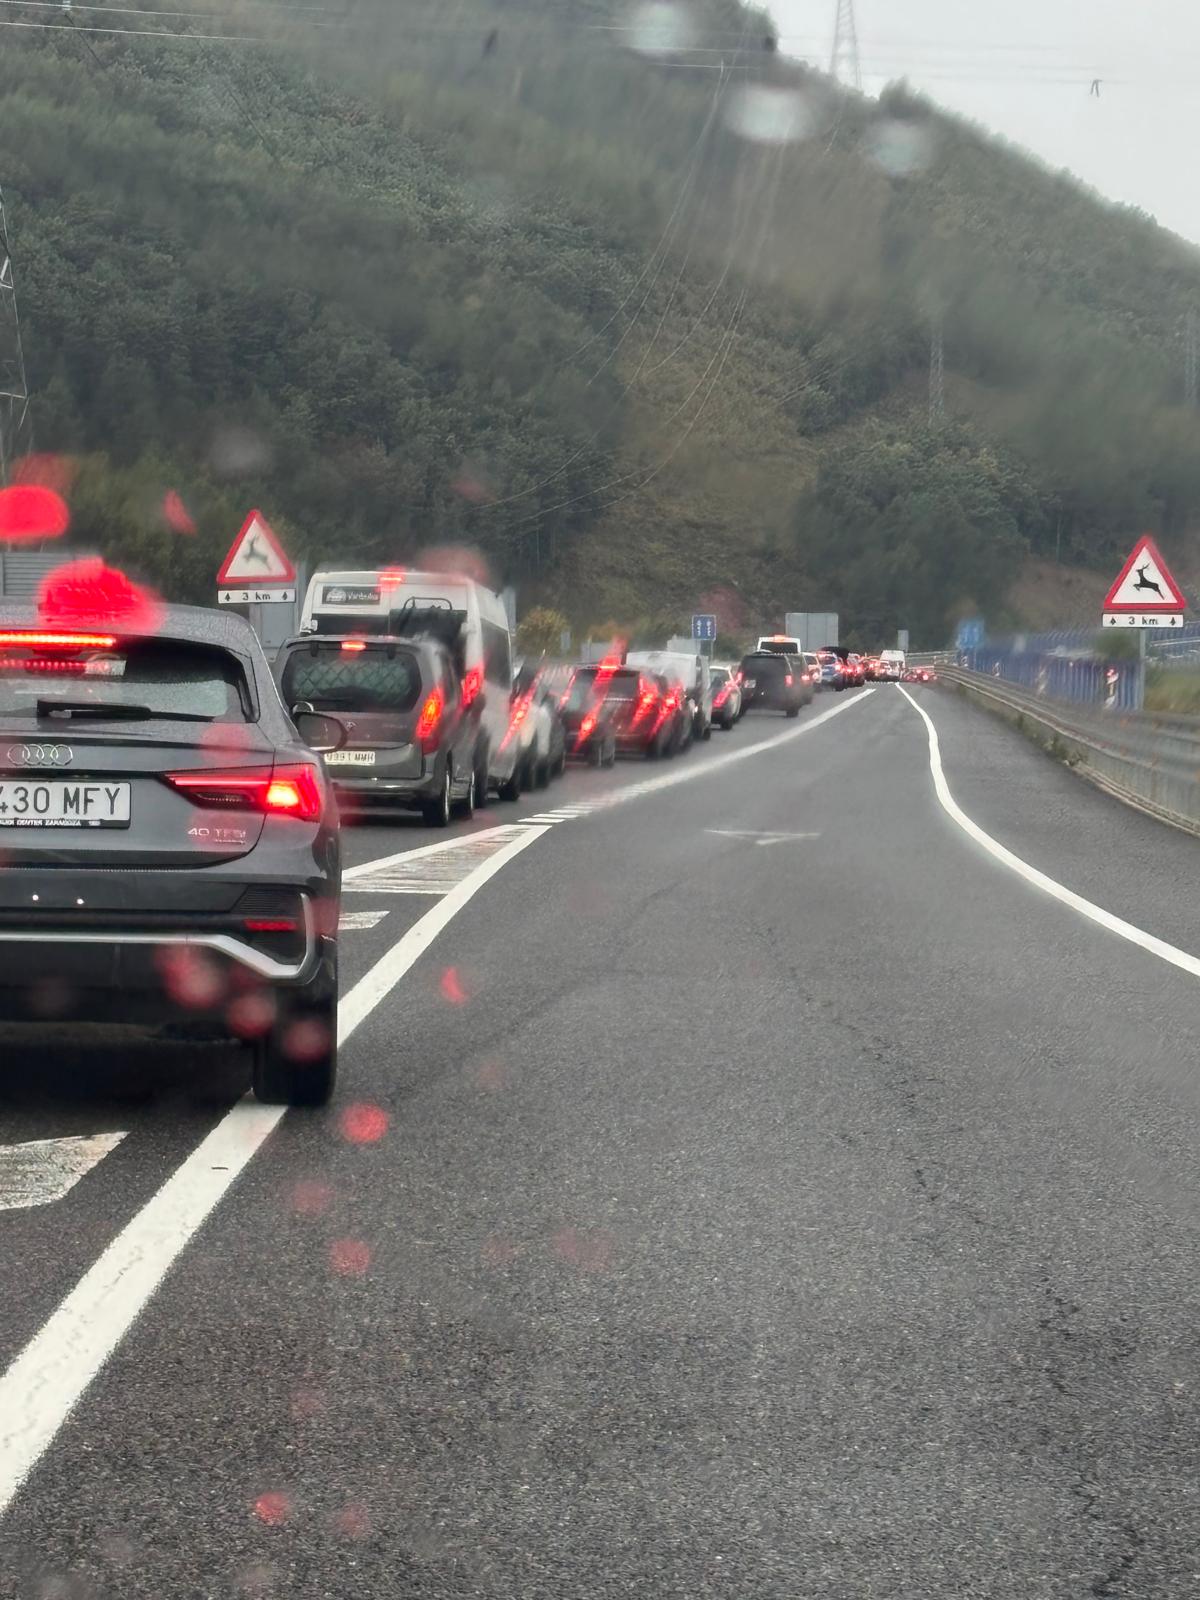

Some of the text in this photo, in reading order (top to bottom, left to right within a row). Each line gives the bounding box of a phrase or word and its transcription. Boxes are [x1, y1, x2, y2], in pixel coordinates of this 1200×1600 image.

[242, 591, 271, 601] 3 km
[1128, 616, 1159, 625] 3 km
[63, 787, 121, 815] MFY
[187, 827, 210, 836] 40
